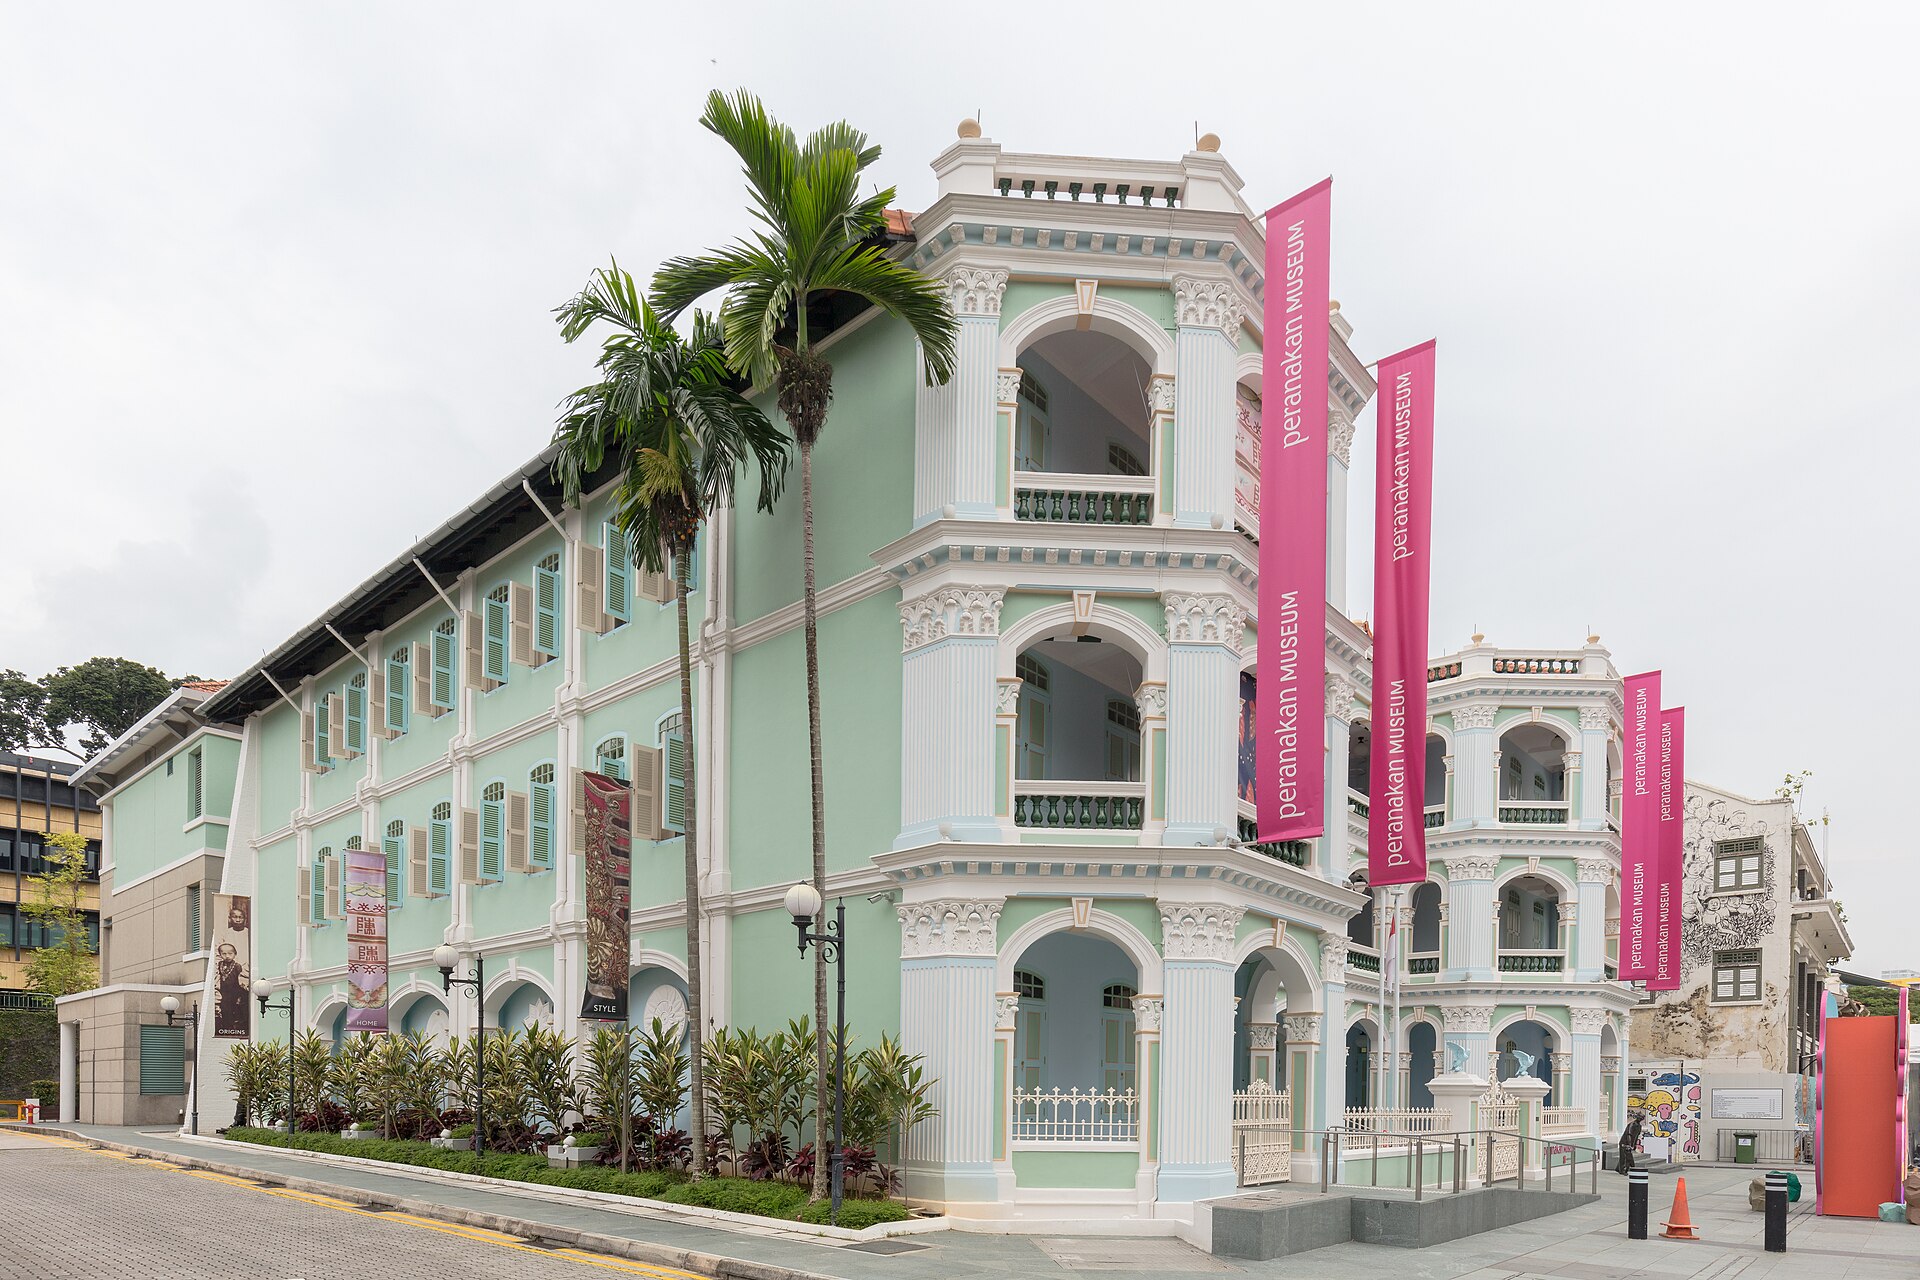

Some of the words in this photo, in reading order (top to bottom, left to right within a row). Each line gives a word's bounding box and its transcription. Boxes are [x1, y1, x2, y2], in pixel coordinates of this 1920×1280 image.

[1285, 219, 1305, 318] MUSEUM
[1280, 315, 1310, 449] peranakan
[1394, 371, 1412, 447] MUSEUM
[1390, 450, 1414, 562] peranakan
[1279, 590, 1299, 681] MUSEUM
[1389, 679, 1405, 755] MUSEUM
[1636, 687, 1647, 732] MUSEUM
[1274, 687, 1306, 820] peranakan
[1633, 733, 1650, 796] peranakan
[1661, 722, 1671, 763] MUSEUM
[1384, 758, 1410, 868] peranakan
[1660, 764, 1674, 822] peranakan
[1633, 862, 1644, 906] MUSEUM
[1660, 882, 1670, 923] MUSEUM
[1630, 907, 1645, 970] peranakan
[1657, 924, 1671, 981] peranakan
[593, 1004, 617, 1013] STYLE
